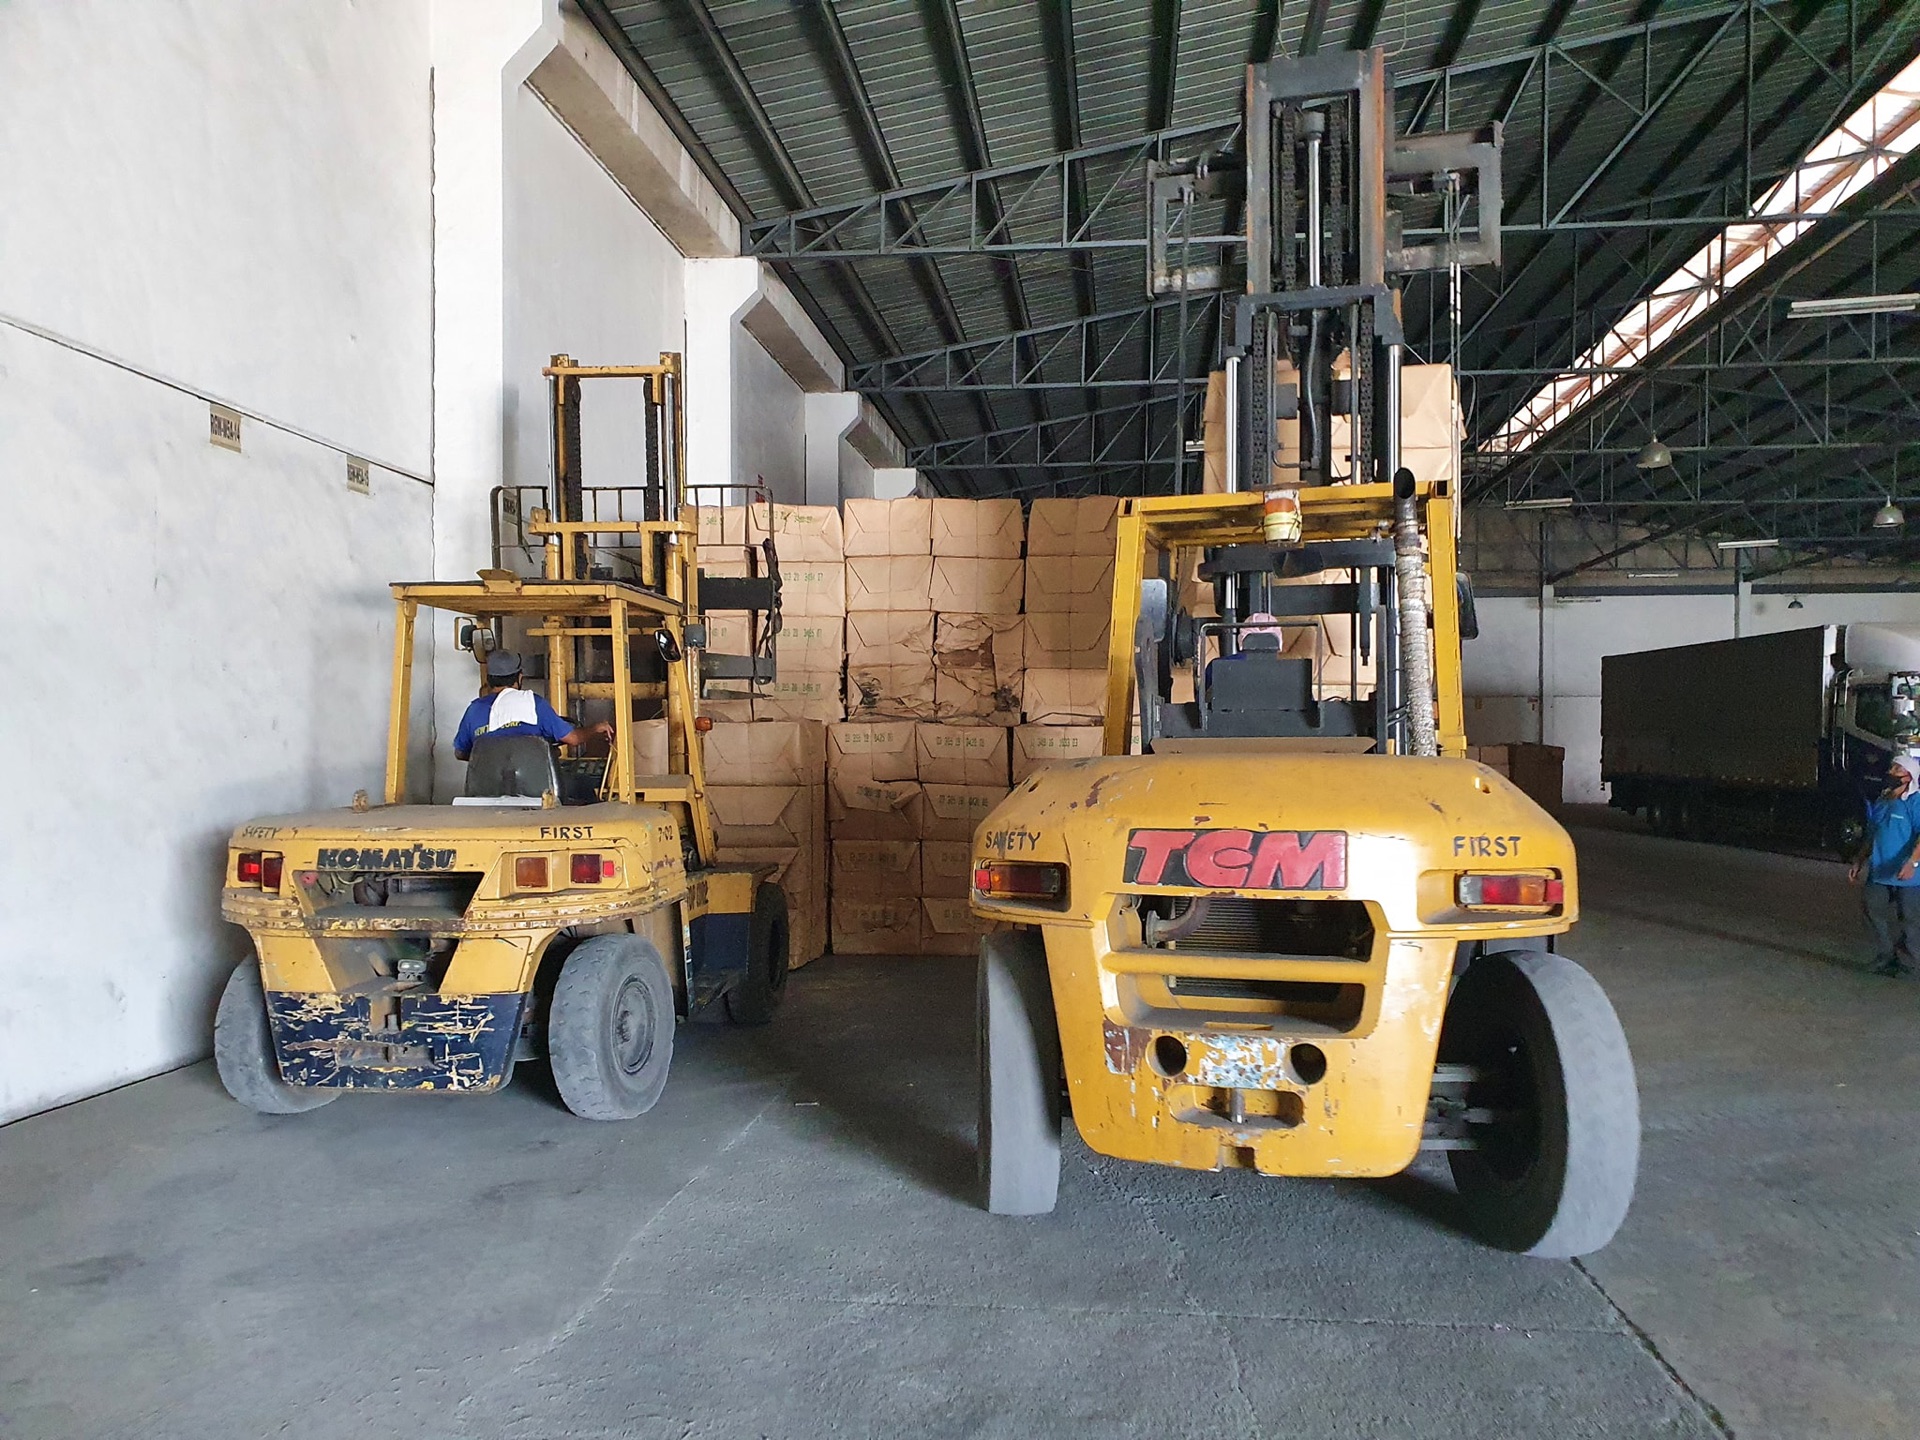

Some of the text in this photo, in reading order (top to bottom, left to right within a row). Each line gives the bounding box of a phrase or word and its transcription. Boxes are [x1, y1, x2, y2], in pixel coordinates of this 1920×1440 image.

[540, 826, 594, 840] FIRST
[985, 831, 1522, 857] SAFETY FIRST
[318, 847, 457, 870] KOMATSU
[1127, 829, 1347, 889] TCM
